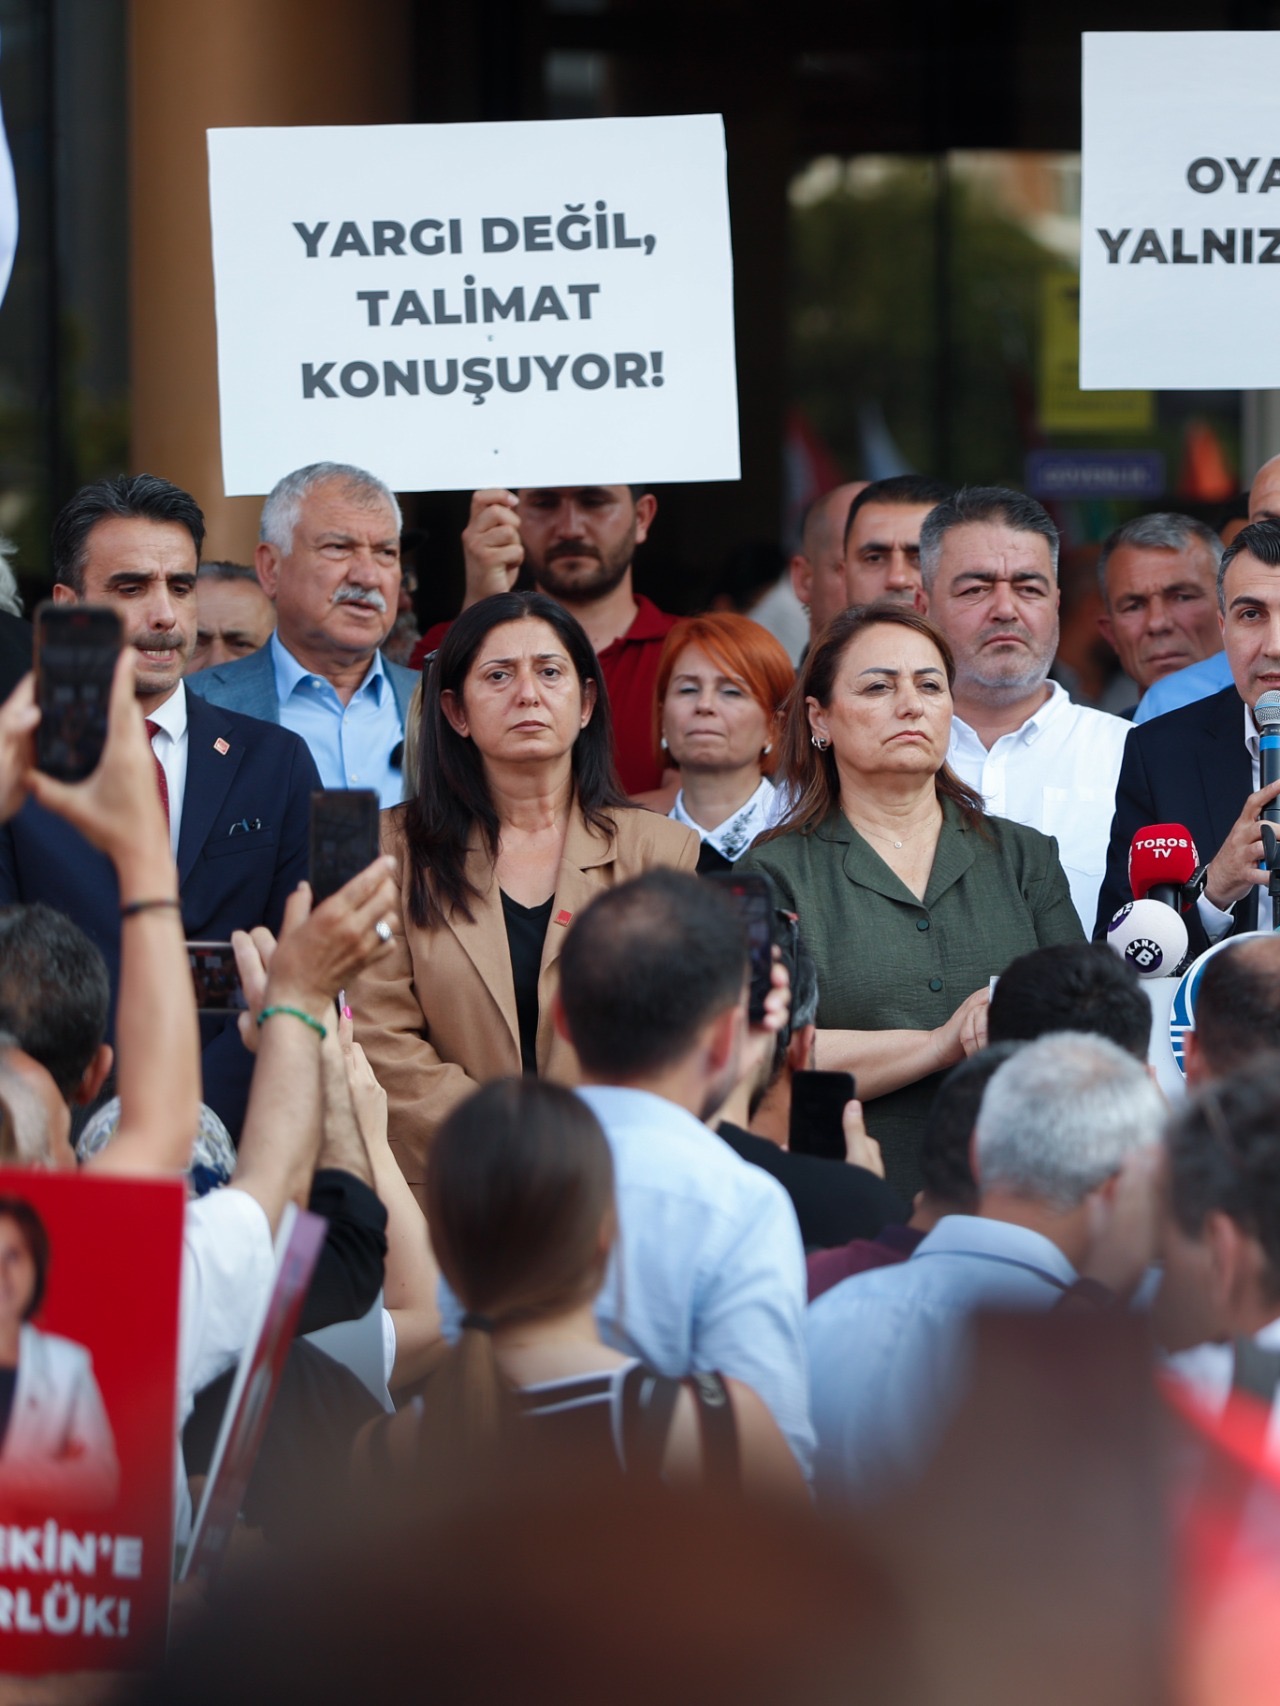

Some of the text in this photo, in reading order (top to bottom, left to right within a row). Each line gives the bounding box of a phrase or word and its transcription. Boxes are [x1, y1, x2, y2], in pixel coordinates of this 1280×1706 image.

[292, 200, 656, 258] YARGI DEĞİL,
[356, 274, 600, 327] TALİMAT
[301, 351, 664, 406] KONUŞUYOR!
[1135, 837, 1188, 851] TOROS
[1152, 848, 1172, 859] TV
[1126, 939, 1161, 957] KANAL
[1135, 948, 1154, 966] B
[0, 1518, 143, 1580] KİN'E
